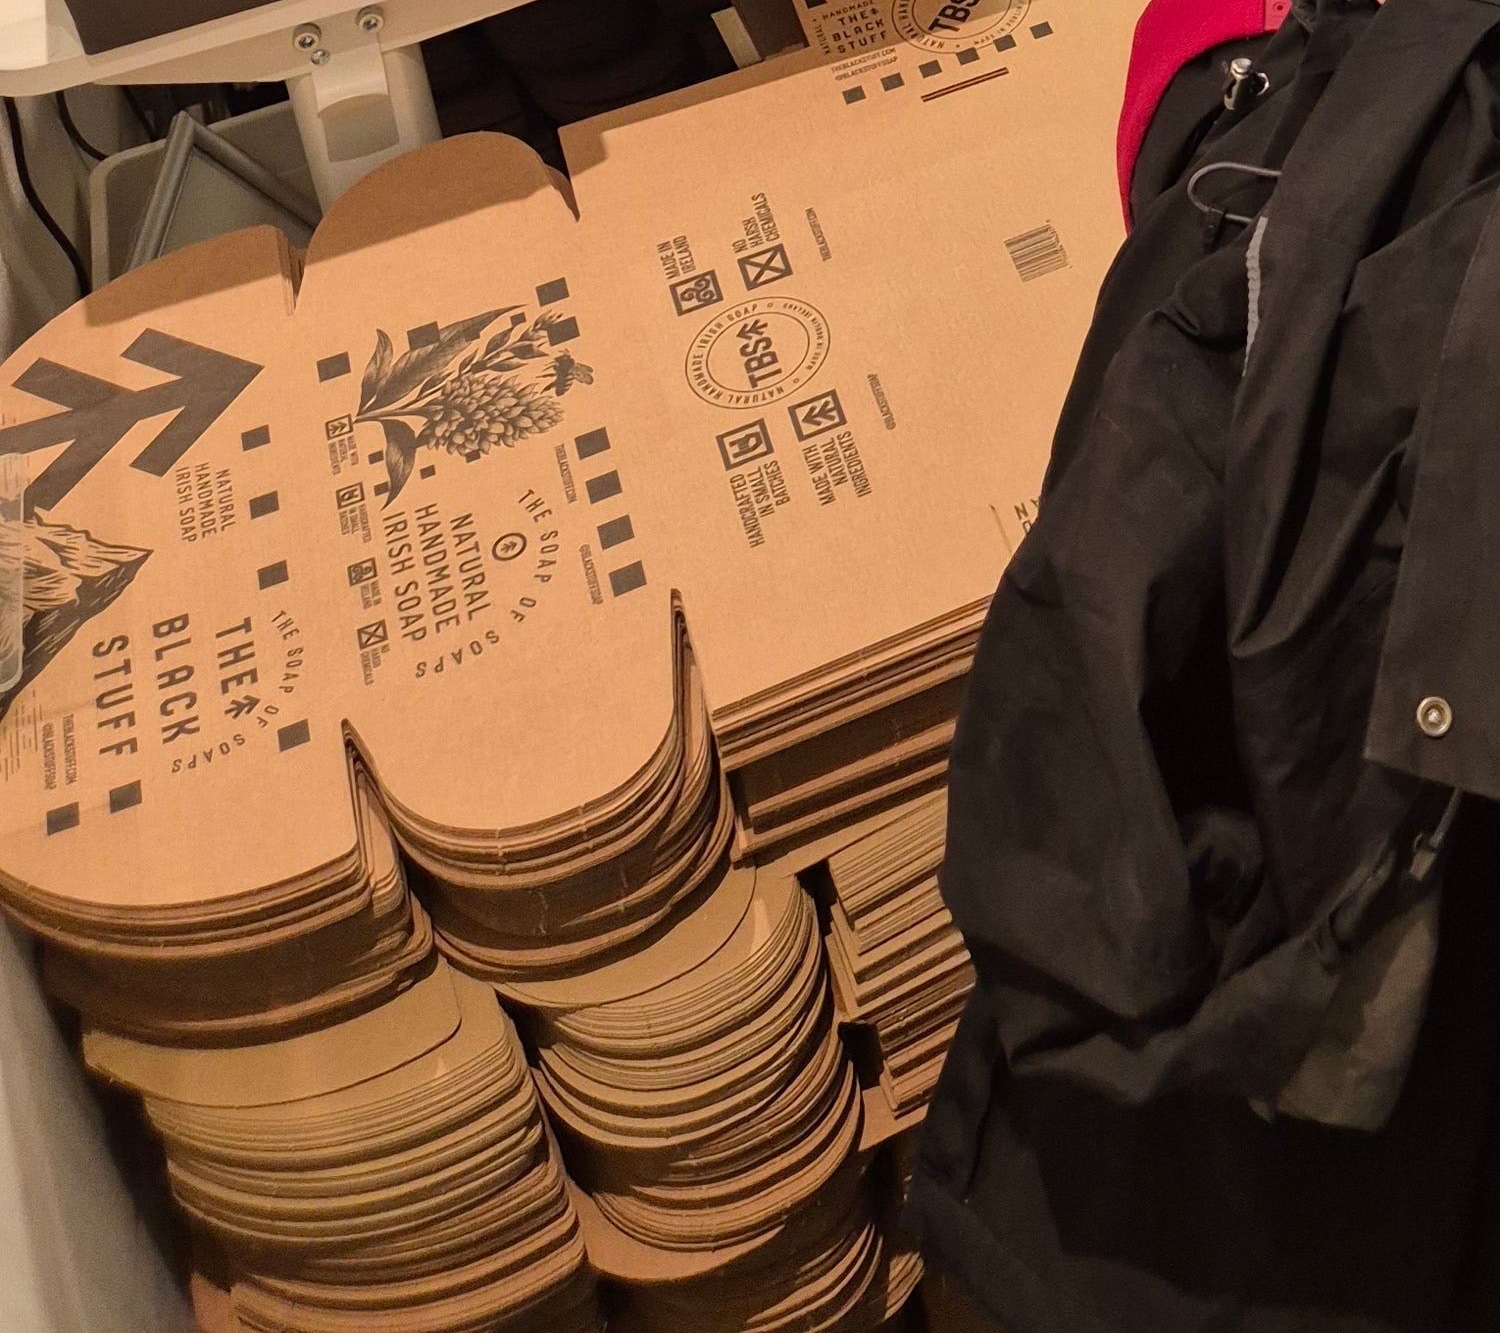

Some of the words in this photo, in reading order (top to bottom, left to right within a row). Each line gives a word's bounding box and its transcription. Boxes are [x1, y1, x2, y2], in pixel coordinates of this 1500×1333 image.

[832, 18, 885, 43] BLACK
[838, 7, 870, 26] THE
[837, 30, 887, 54] STUFF
[741, 216, 765, 249] HARSH
[751, 192, 781, 244] CHEMICALS
[656, 240, 672, 253] IN
[660, 253, 681, 280] MADE
[672, 235, 697, 275] IRELAND
[731, 238, 748, 254] NO
[691, 353, 722, 401] HANDMADE
[739, 335, 782, 389] TBS
[727, 384, 785, 406] NATURAL
[801, 443, 825, 474] WITH
[819, 436, 849, 487] NATURAL
[836, 430, 873, 498] INGREDIENTS
[175, 466, 195, 505] IRISH
[195, 461, 218, 539] HANDMADE
[215, 467, 237, 532] NATURAL
[747, 465, 771, 505] SMALL
[763, 459, 791, 507] BATCHES
[811, 472, 837, 507] MADE
[179, 506, 198, 543] SOAP
[518, 488, 553, 523] THE
[729, 473, 766, 549] HANDCRAFTED
[758, 502, 776, 518] IN
[382, 511, 416, 576] IRISH
[533, 529, 560, 584] SOAP
[414, 502, 461, 634] HANDMADE
[449, 512, 492, 621] NATURAL
[270, 609, 300, 641] THE
[393, 580, 428, 642] SOAP
[510, 596, 537, 624] OF
[215, 616, 259, 696] THE
[278, 647, 305, 695] SOAP
[414, 630, 501, 678] SOAPS
[91, 634, 139, 756] STUFF
[152, 612, 201, 745] BLACK
[256, 704, 280, 729] OF
[171, 733, 246, 774] SOAPS
